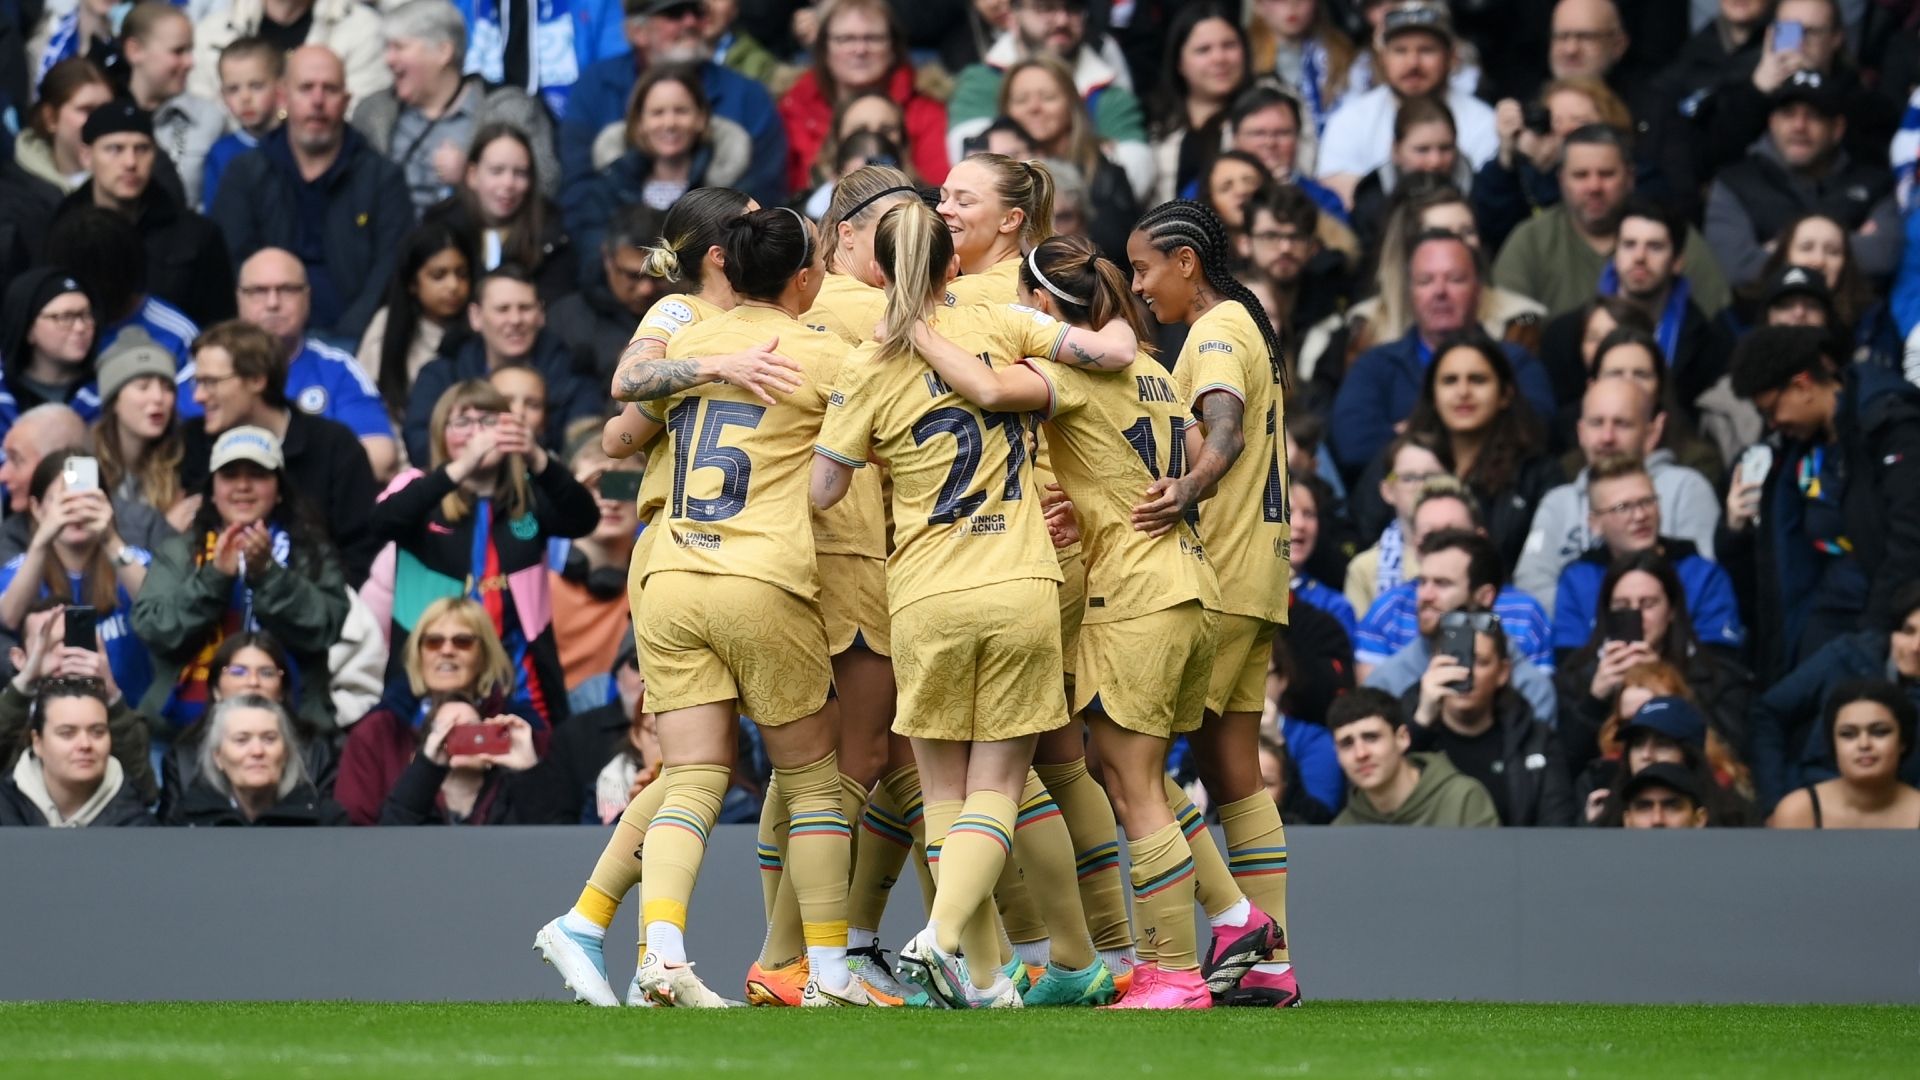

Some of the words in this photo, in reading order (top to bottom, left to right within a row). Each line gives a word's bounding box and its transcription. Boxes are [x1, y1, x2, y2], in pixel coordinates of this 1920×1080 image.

[1199, 341, 1233, 353] BIMBO
[668, 396, 766, 522] 15
[911, 406, 1025, 526] 21
[970, 514, 1005, 524] UNHCR
[970, 523, 1006, 533] ACNUR
[685, 532, 721, 543] UNHCR
[684, 539, 721, 550] ACNUR
